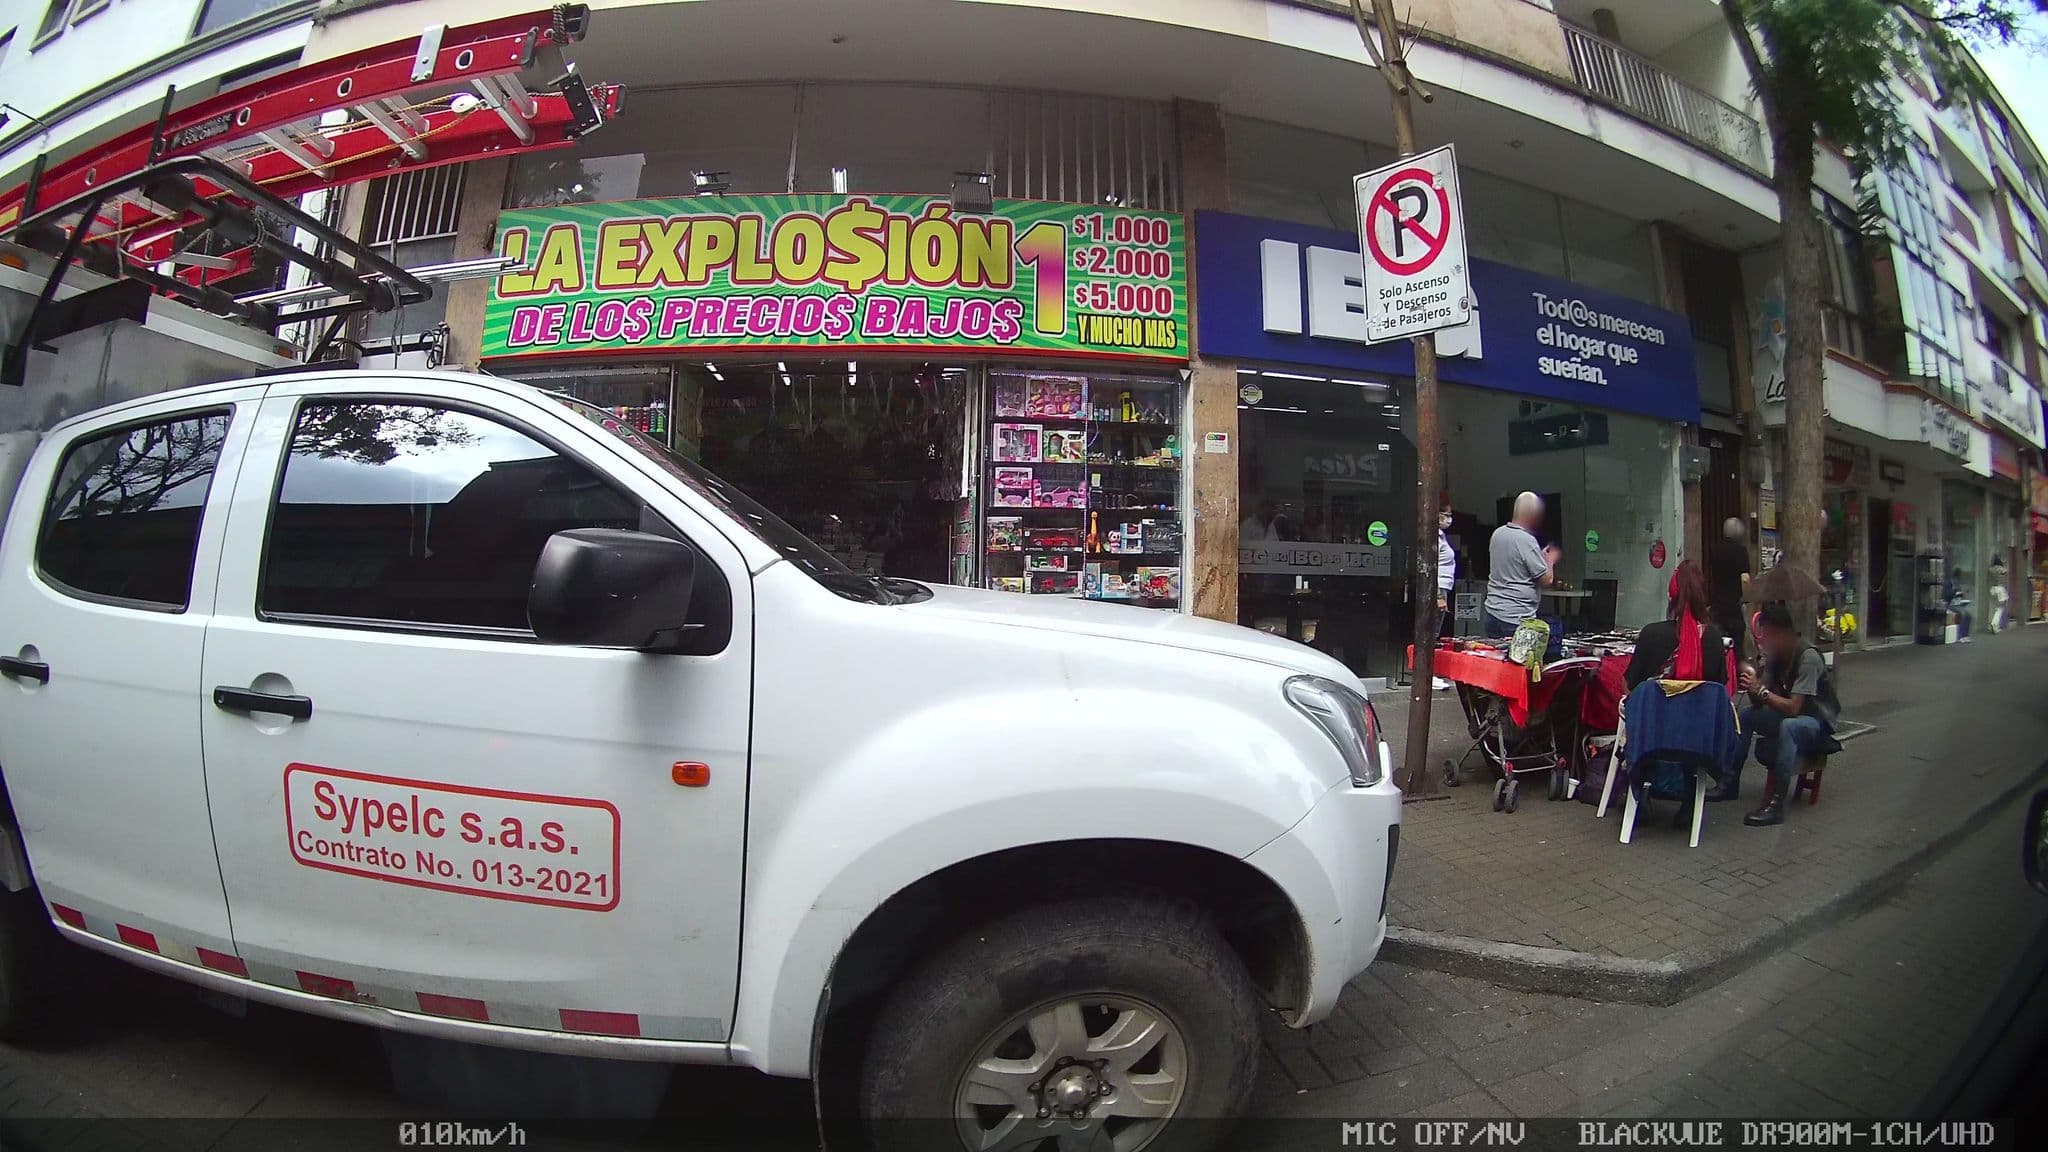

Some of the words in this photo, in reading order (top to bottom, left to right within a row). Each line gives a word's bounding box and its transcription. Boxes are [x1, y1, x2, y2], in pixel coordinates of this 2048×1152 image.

[1073, 213, 1170, 246] $1.000
[500, 228, 583, 296] LA
[597, 200, 1013, 294] EXPLO$IÓN
[1074, 246, 1171, 279] $2.000
[1015, 222, 1067, 336] 1
[1379, 284, 1402, 300] Solo
[1404, 274, 1450, 293] Ascenso
[1075, 282, 1173, 315] $5.000
[1383, 302, 1390, 313] Y
[1395, 290, 1448, 311] Descenso
[508, 303, 567, 346] DE
[568, 298, 654, 342] LO$
[659, 294, 858, 341] PRECIO$
[863, 298, 1025, 343] BAJO$
[1077, 315, 1088, 344] Y
[1089, 316, 1143, 347] MUCHO
[1144, 319, 1176, 349] MAS
[1384, 317, 1397, 329] de
[1399, 306, 1452, 327] Pasajeros
[1532, 292, 1598, 327] Tod@s
[1599, 313, 1665, 345] merecen
[1536, 323, 1554, 346] el
[1555, 325, 1606, 359] hogar
[1607, 343, 1639, 366] que
[1538, 356, 1608, 385] sueñan.
[313, 780, 446, 837] Sypelc
[460, 812, 579, 855] s.a.s.
[297, 830, 406, 869] Contrato
[416, 850, 462, 880] No.
[472, 859, 608, 897] 013-2021
